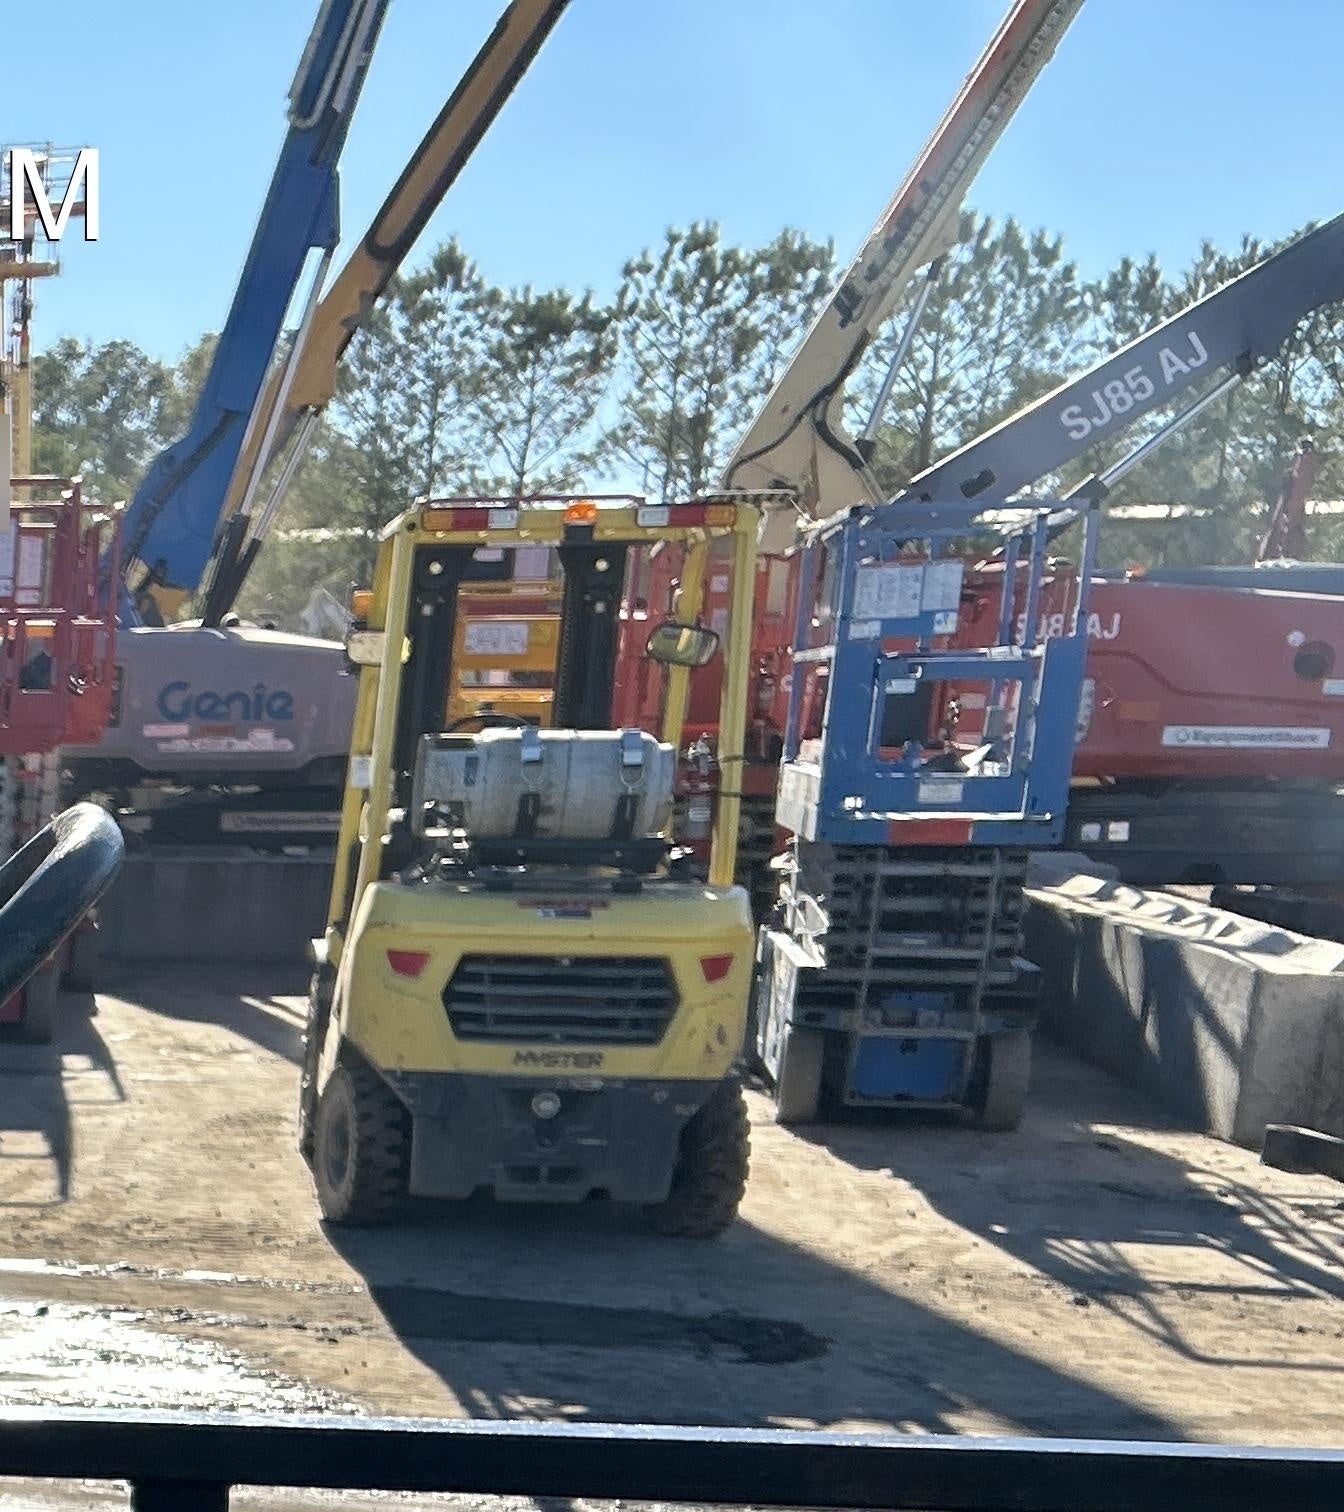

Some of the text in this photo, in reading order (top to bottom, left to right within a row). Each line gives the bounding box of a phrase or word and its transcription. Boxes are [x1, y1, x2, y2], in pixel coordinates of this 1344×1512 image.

[1060, 331, 1209, 440] SJ85 AJ
[1086, 611, 1121, 640] AJ
[157, 681, 295, 721] Genie
[513, 1050, 604, 1068] HYSTER
